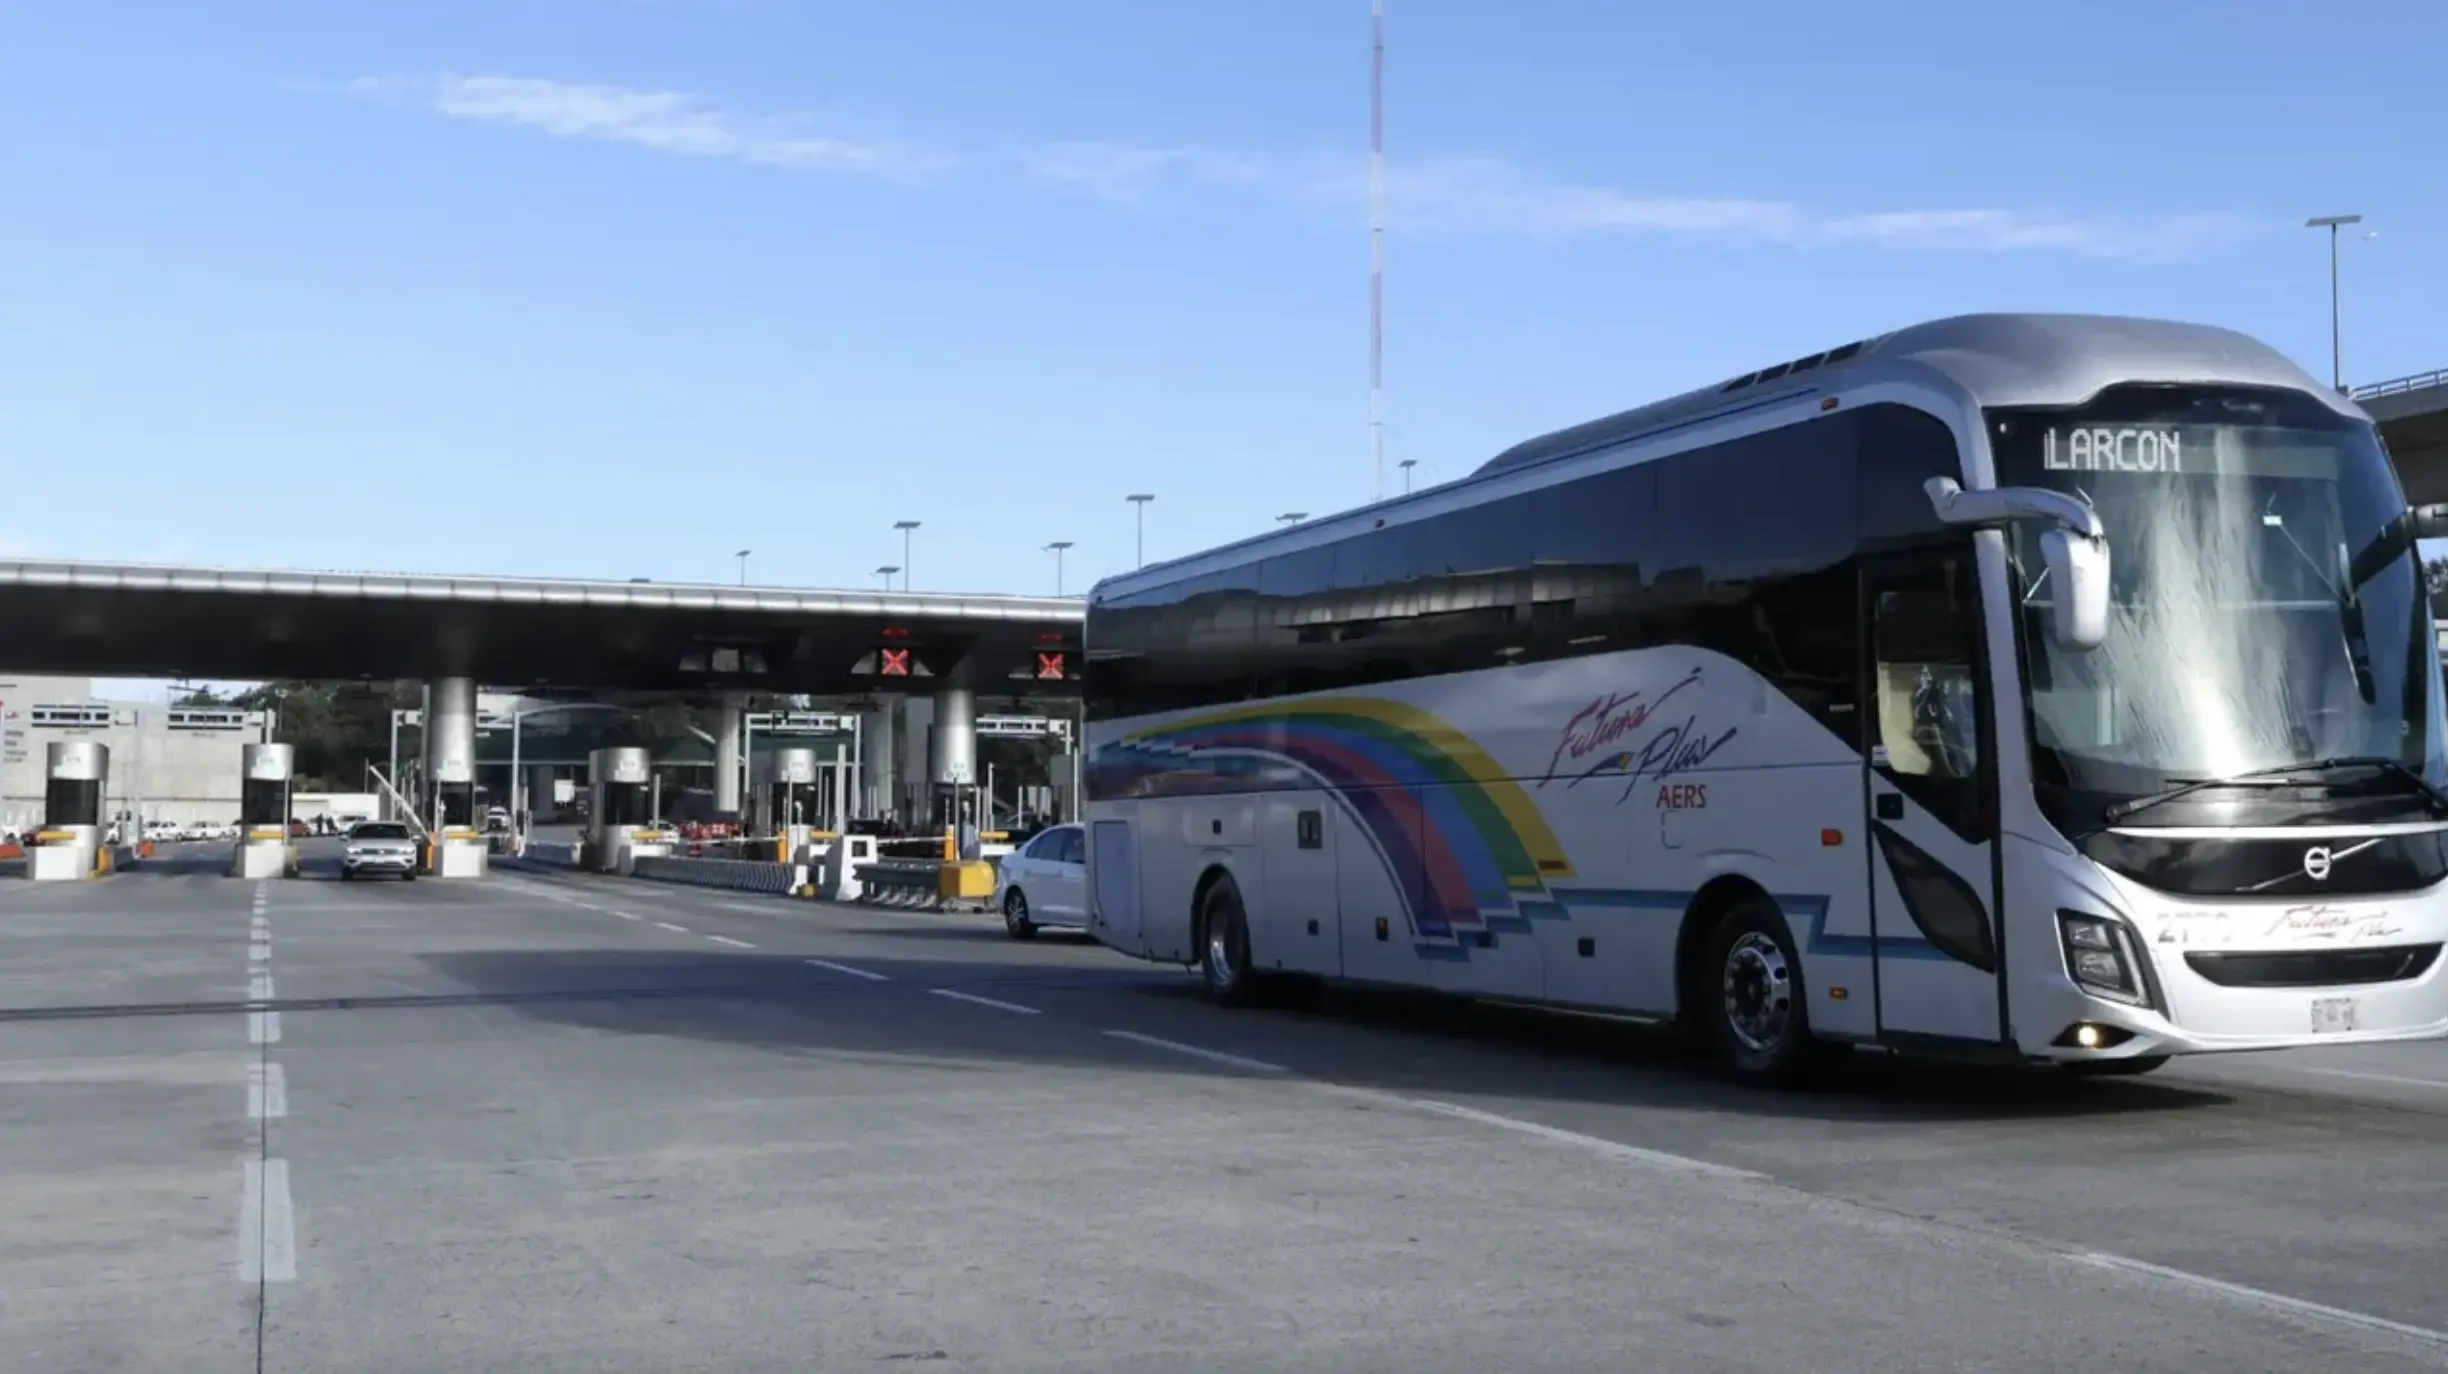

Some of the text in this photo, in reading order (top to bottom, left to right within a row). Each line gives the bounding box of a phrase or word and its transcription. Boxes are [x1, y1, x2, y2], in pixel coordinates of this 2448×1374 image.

[1537, 675, 1699, 788] Futura
[1616, 714, 1737, 806] Plus
[1656, 784, 1707, 809] AERS
